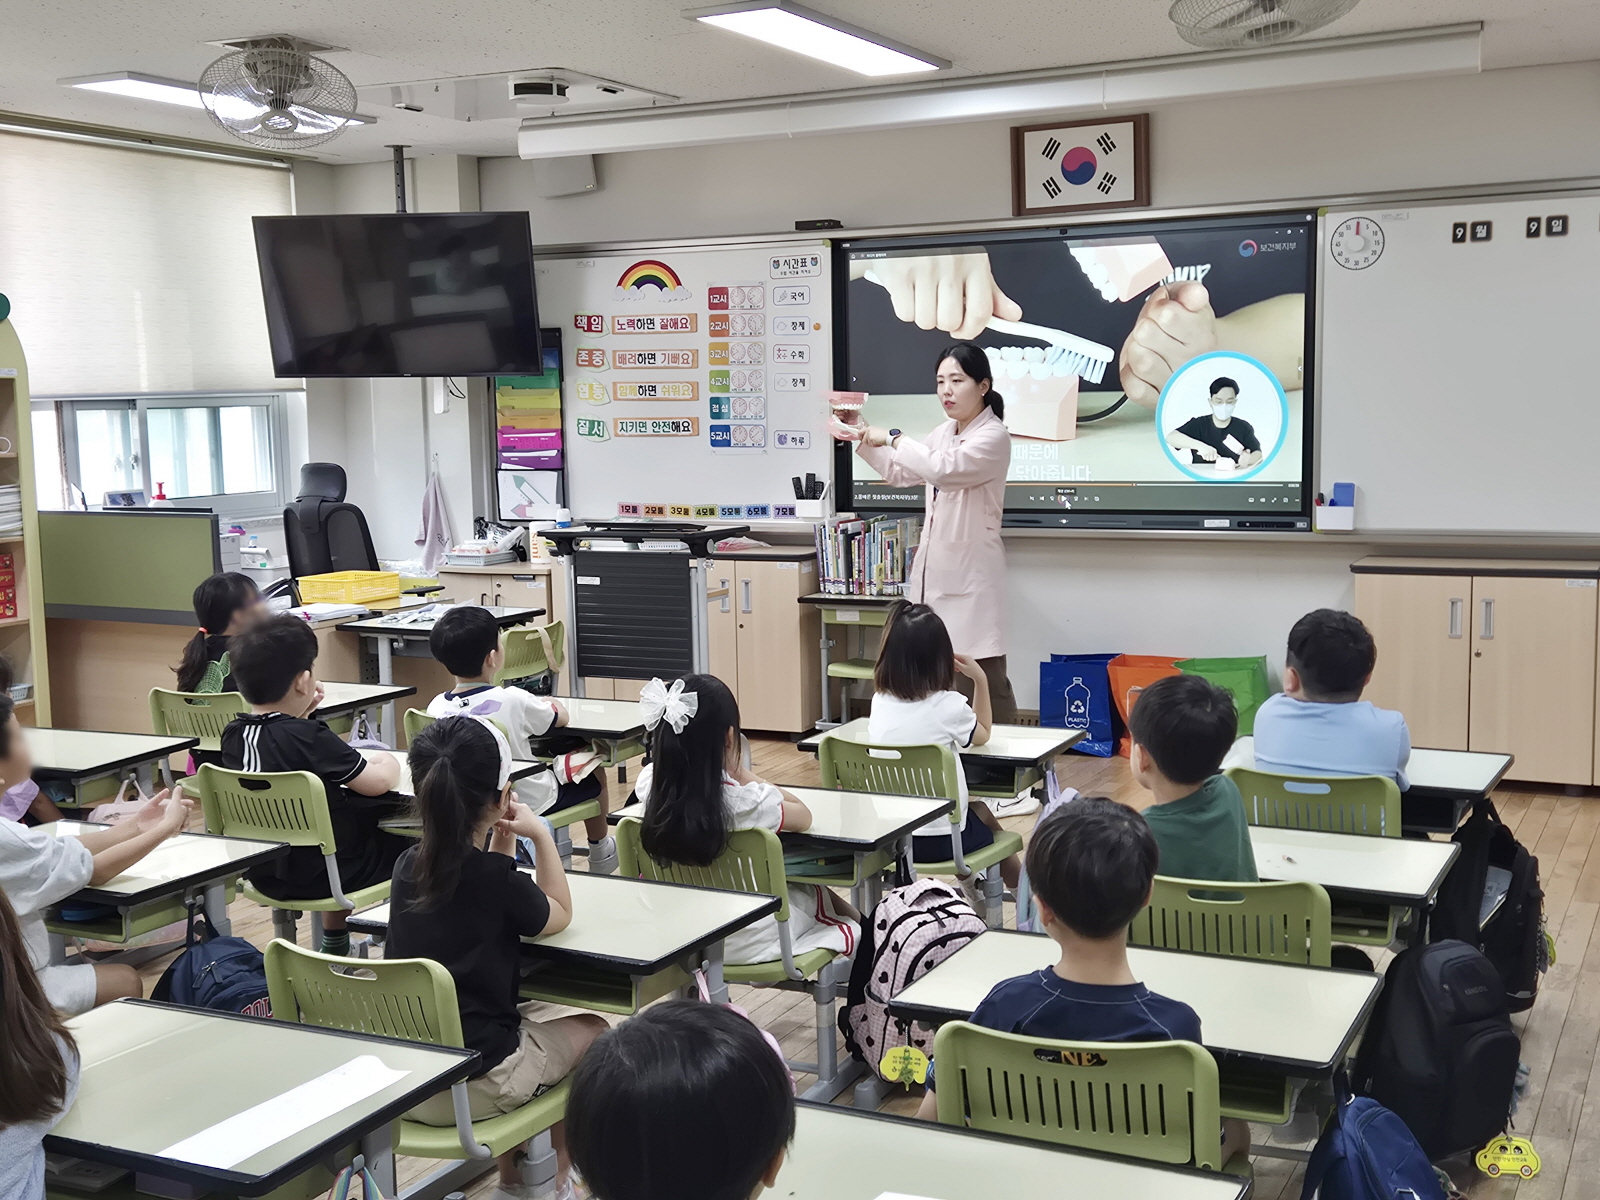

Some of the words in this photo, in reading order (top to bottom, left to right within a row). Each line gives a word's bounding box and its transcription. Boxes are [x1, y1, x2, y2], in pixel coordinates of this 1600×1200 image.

[1551, 219, 1563, 232] 일
[1260, 242, 1297, 252] 보건복지부
[783, 257, 808, 269] 시간표
[710, 294, 727, 303] 1교시
[791, 291, 805, 301] 국어
[576, 315, 602, 331] 책임
[617, 318, 655, 331] 노력하면
[660, 317, 689, 330] 잘해요
[710, 321, 729, 331] 2교시
[578, 350, 604, 365] 존중
[618, 352, 656, 365] 배려하면
[661, 352, 690, 365] 기뻐요
[710, 349, 729, 359] 3교시
[791, 350, 805, 360] 수학
[710, 377, 729, 386] 4교시
[578, 384, 604, 399] 협동
[619, 384, 657, 397] 함께하면
[661, 384, 691, 397] 쉬워요
[712, 404, 728, 413] 점심
[578, 419, 604, 436] 질서
[619, 421, 648, 433] 지키면
[651, 420, 691, 433] 안전해요
[711, 431, 730, 440] 5교시
[791, 437, 805, 446] 하루
[1013, 443, 1059, 460] 때문에
[621, 505, 638, 514] 1모둠
[645, 506, 664, 515] 2모둠
[670, 507, 689, 516] 3모둠
[696, 508, 715, 516] 4모둠
[721, 507, 741, 516] 5모둠
[747, 506, 768, 516] 6모둠
[775, 507, 795, 516] 7모둠
